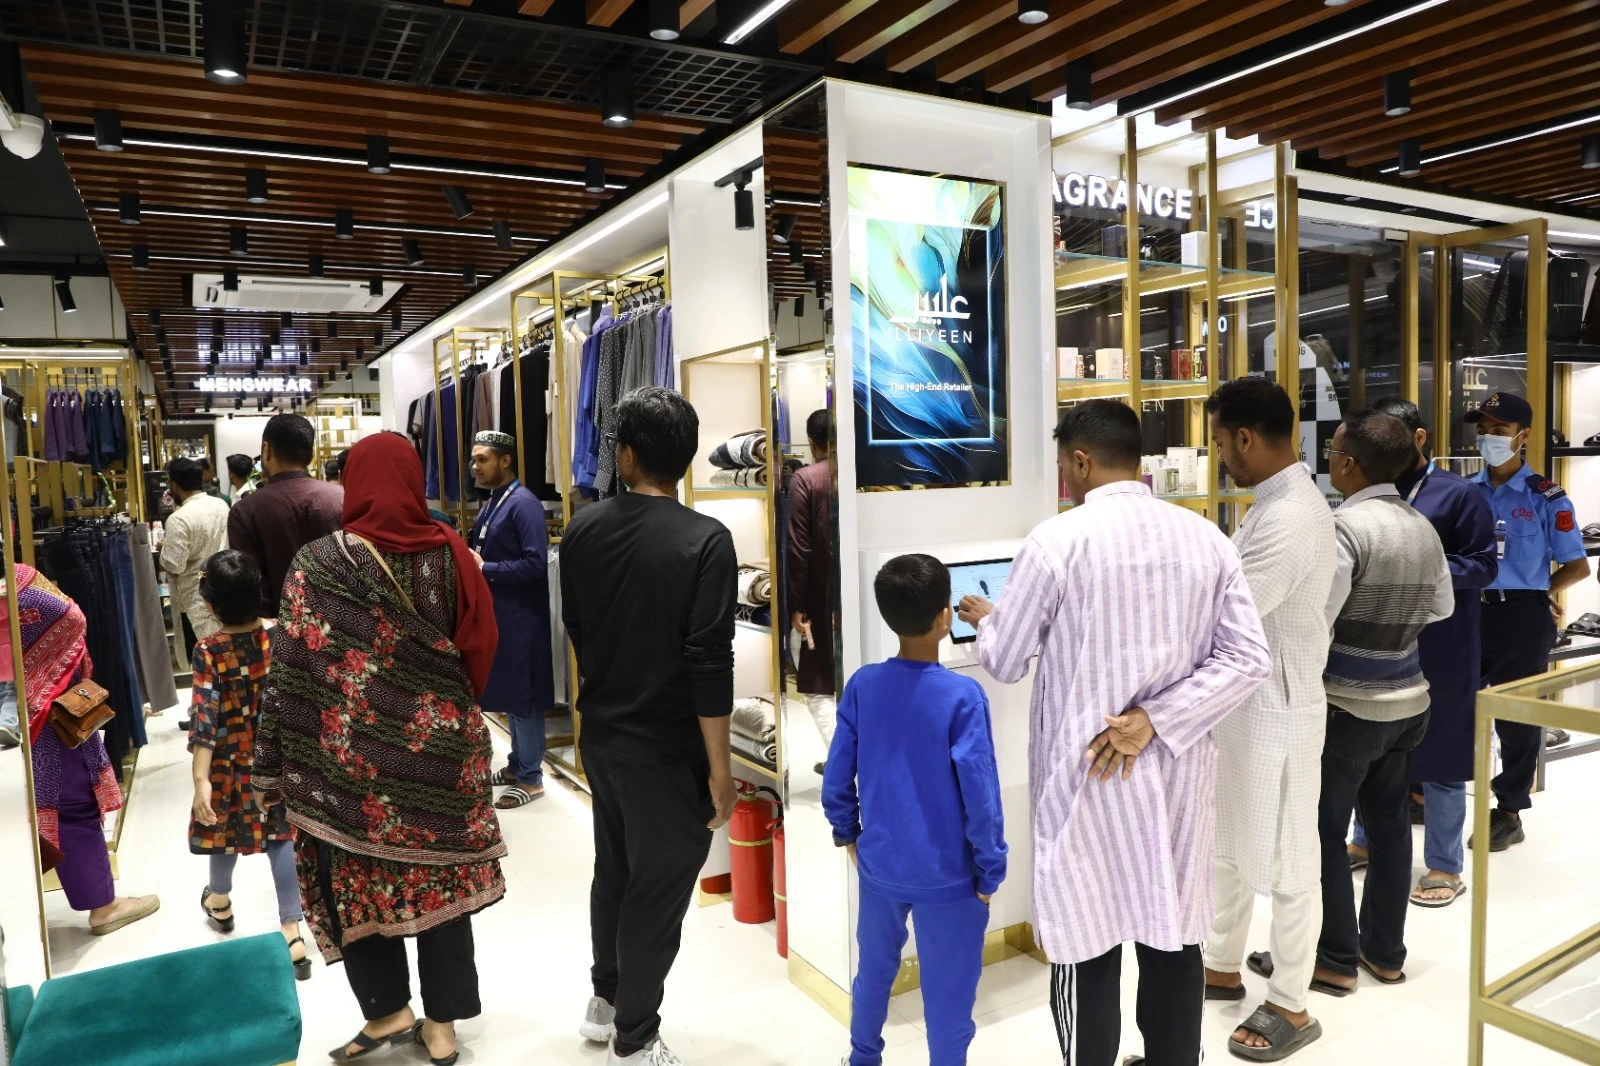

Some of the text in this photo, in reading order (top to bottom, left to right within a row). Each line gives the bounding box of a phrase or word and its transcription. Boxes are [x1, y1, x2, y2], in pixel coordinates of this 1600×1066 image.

[888, 328, 972, 344] ILLIYEEN
[199, 378, 313, 392] MENSWEAR
[891, 382, 972, 393] The High-End Retailer
